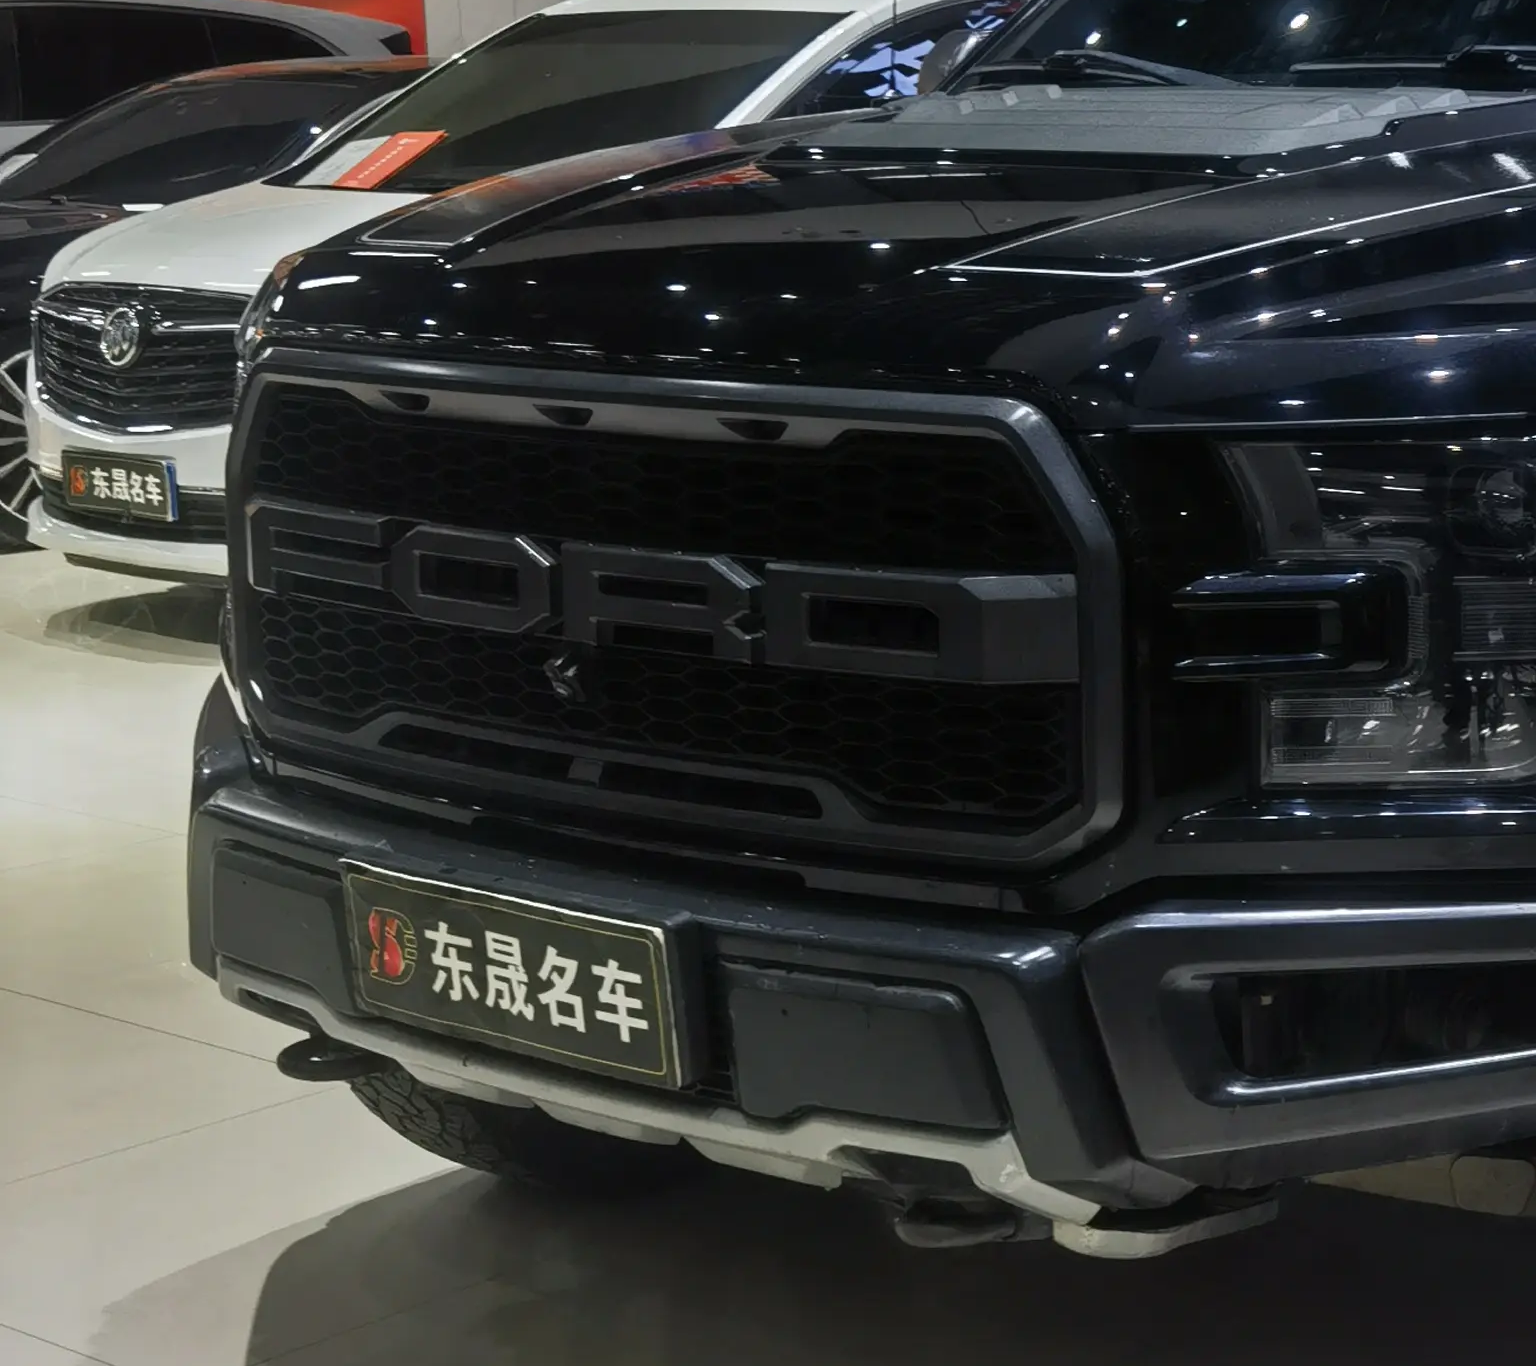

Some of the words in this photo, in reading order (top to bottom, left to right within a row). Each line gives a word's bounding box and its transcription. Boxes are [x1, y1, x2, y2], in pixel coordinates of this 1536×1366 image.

[90, 466, 165, 507] 东晟名车
[246, 497, 990, 680] FORD
[424, 921, 650, 1044] 东晟名车
